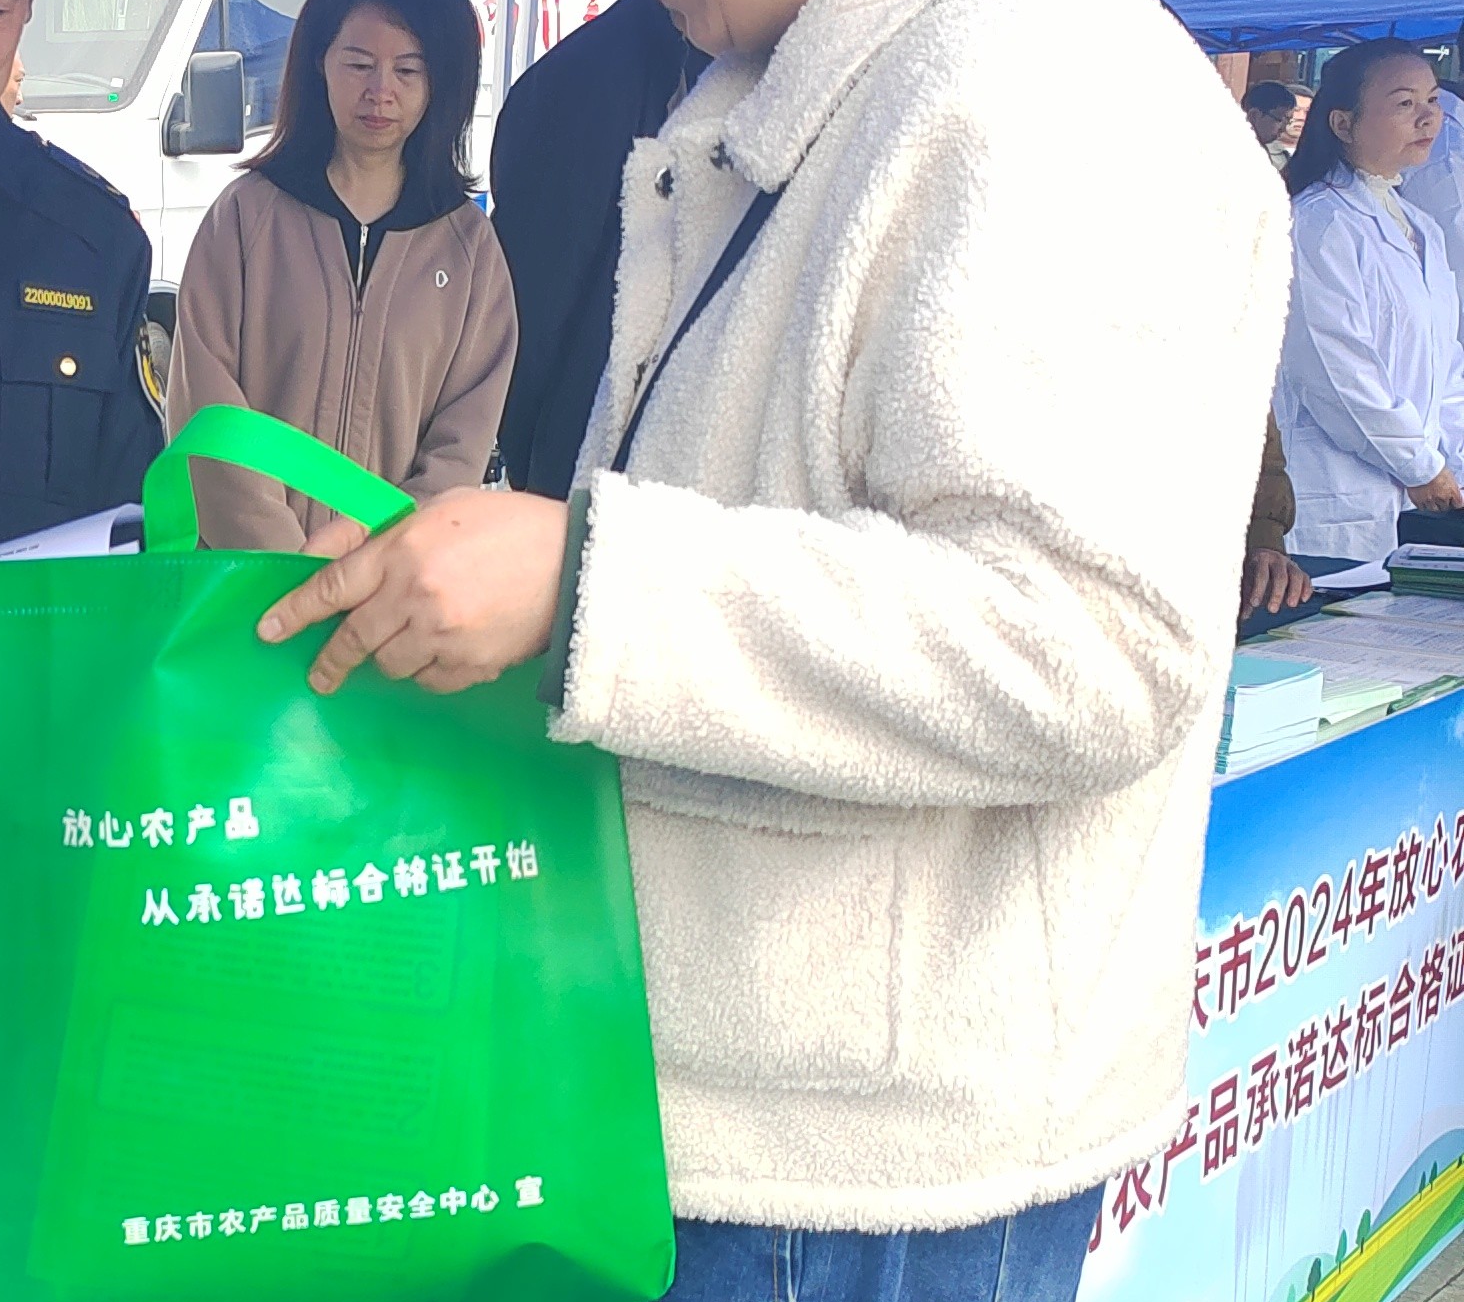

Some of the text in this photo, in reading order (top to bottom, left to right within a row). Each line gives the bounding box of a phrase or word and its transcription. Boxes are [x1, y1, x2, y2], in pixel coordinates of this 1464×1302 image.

[62, 796, 259, 849] 放心农产品
[141, 839, 539, 926] 从承诺达标合格证开始
[1088, 930, 1464, 1253] 农产品承诺达标合格证
[122, 1175, 545, 1246] 重庆市农产品质量安全中心 宣
